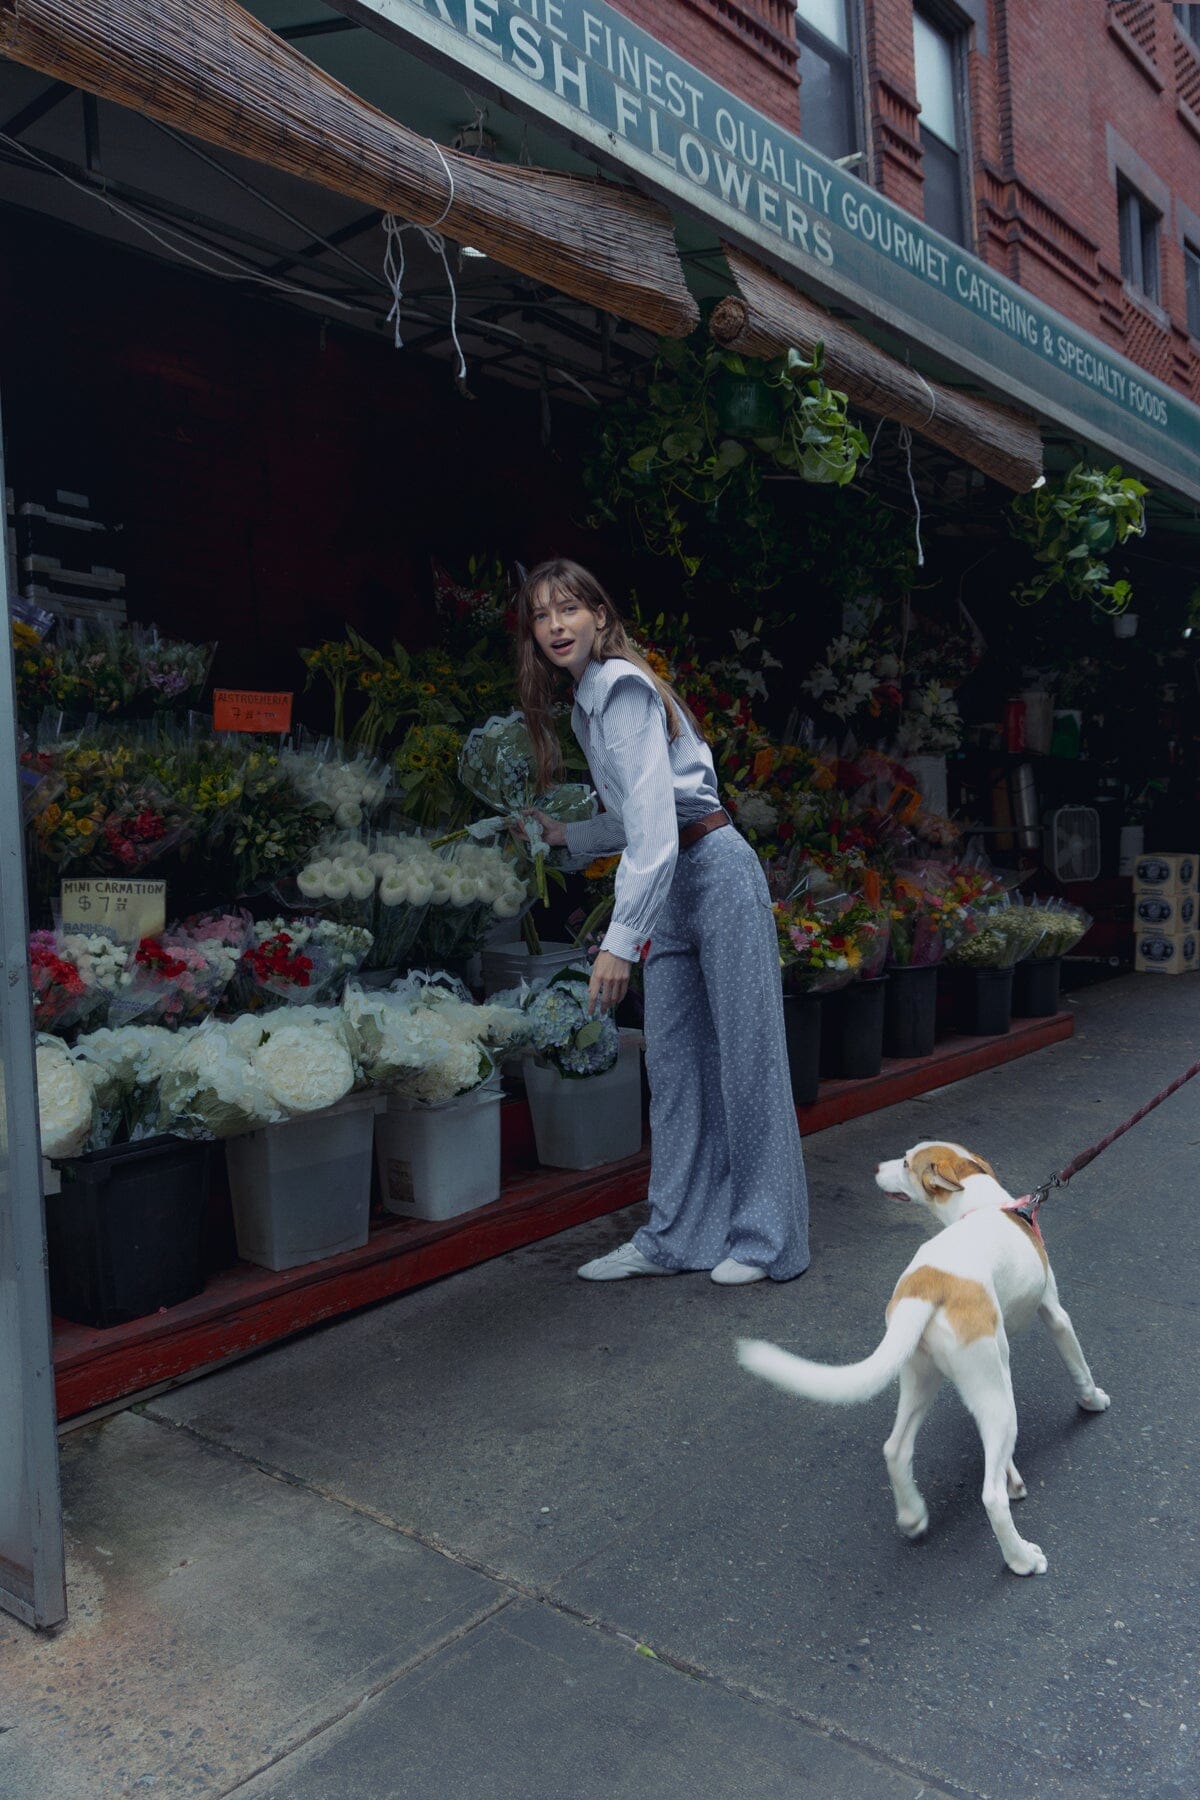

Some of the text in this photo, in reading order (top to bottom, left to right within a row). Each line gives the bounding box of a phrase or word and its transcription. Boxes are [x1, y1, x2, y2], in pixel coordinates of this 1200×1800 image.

[583, 10, 704, 129] FINEST
[715, 108, 834, 214] QUALITY
[841, 192, 949, 287] GOURMET
[955, 264, 1039, 345] CATERING
[1042, 326, 1054, 356] &
[1057, 336, 1128, 400] SPECIALTY
[1129, 380, 1168, 426] FOODS
[614, 84, 836, 266] FLOWERS
[64, 882, 164, 895] MINI CARNATION
